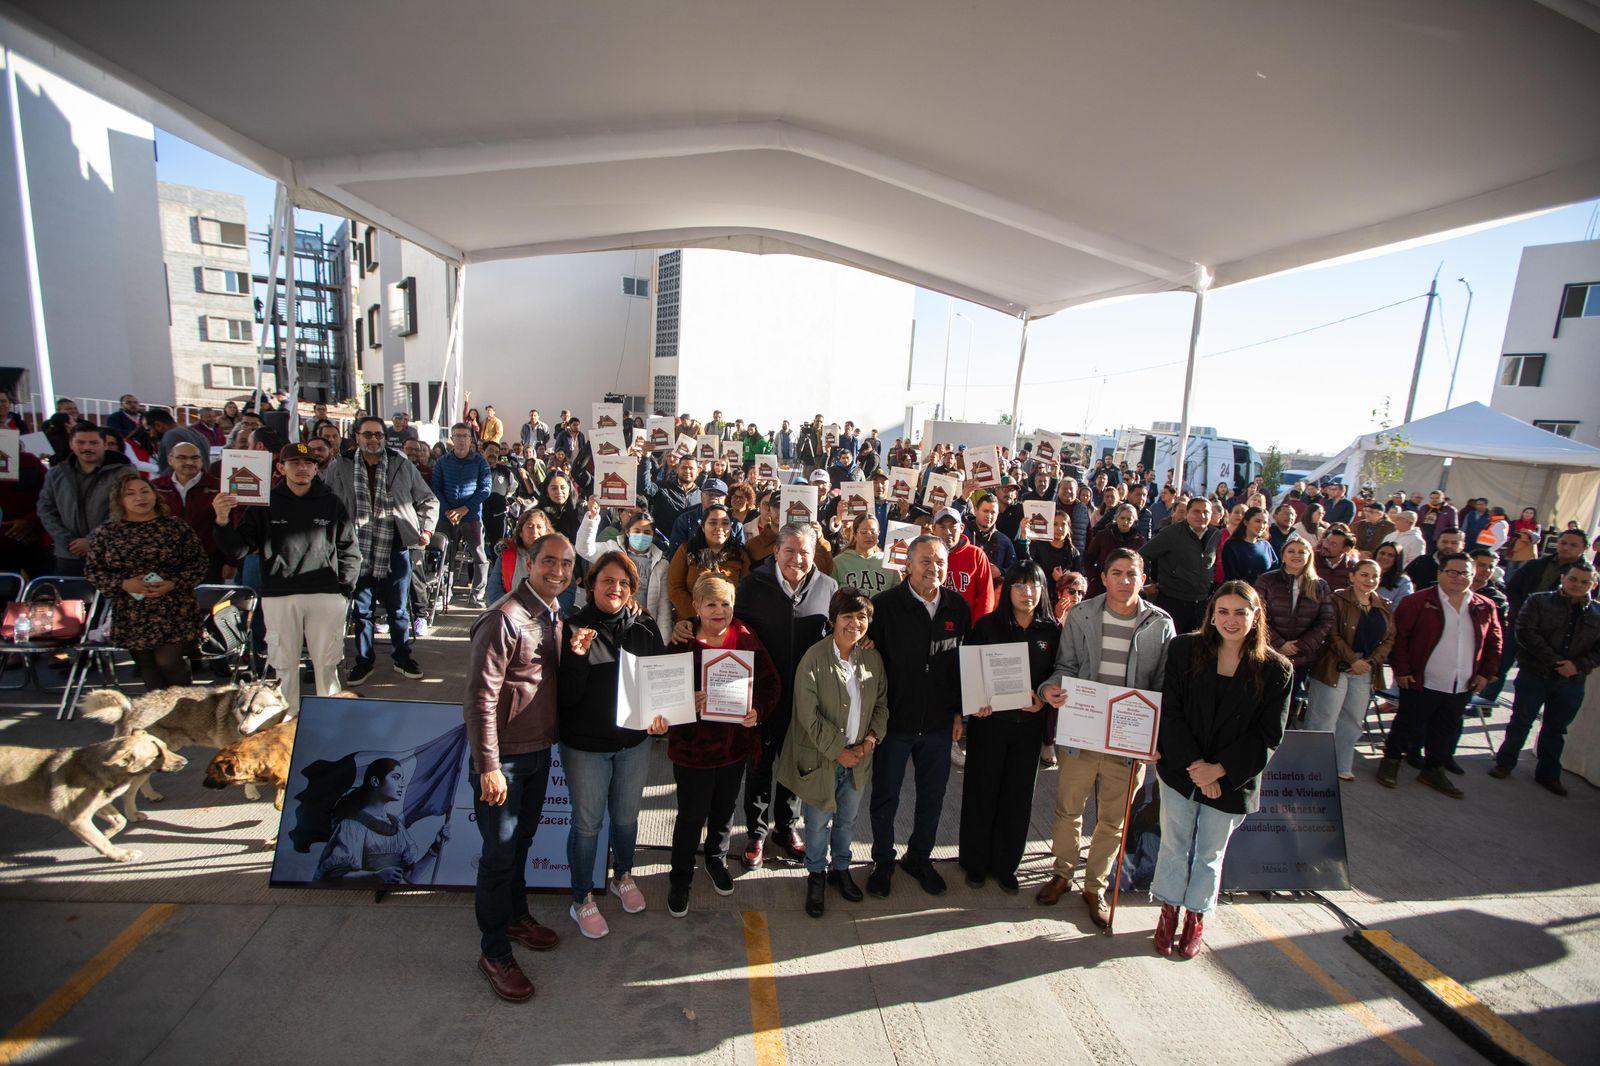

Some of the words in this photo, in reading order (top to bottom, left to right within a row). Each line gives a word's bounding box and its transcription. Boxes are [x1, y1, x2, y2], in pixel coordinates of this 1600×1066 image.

[1220, 462, 1230, 478] 24
[846, 570, 886, 592] GAP
[945, 571, 971, 593] AP
[1261, 771, 1306, 782] eficiarios
[1308, 771, 1322, 782] del
[1260, 788, 1279, 798] ama
[1282, 787, 1293, 798] de
[1296, 787, 1336, 798] Vivienda
